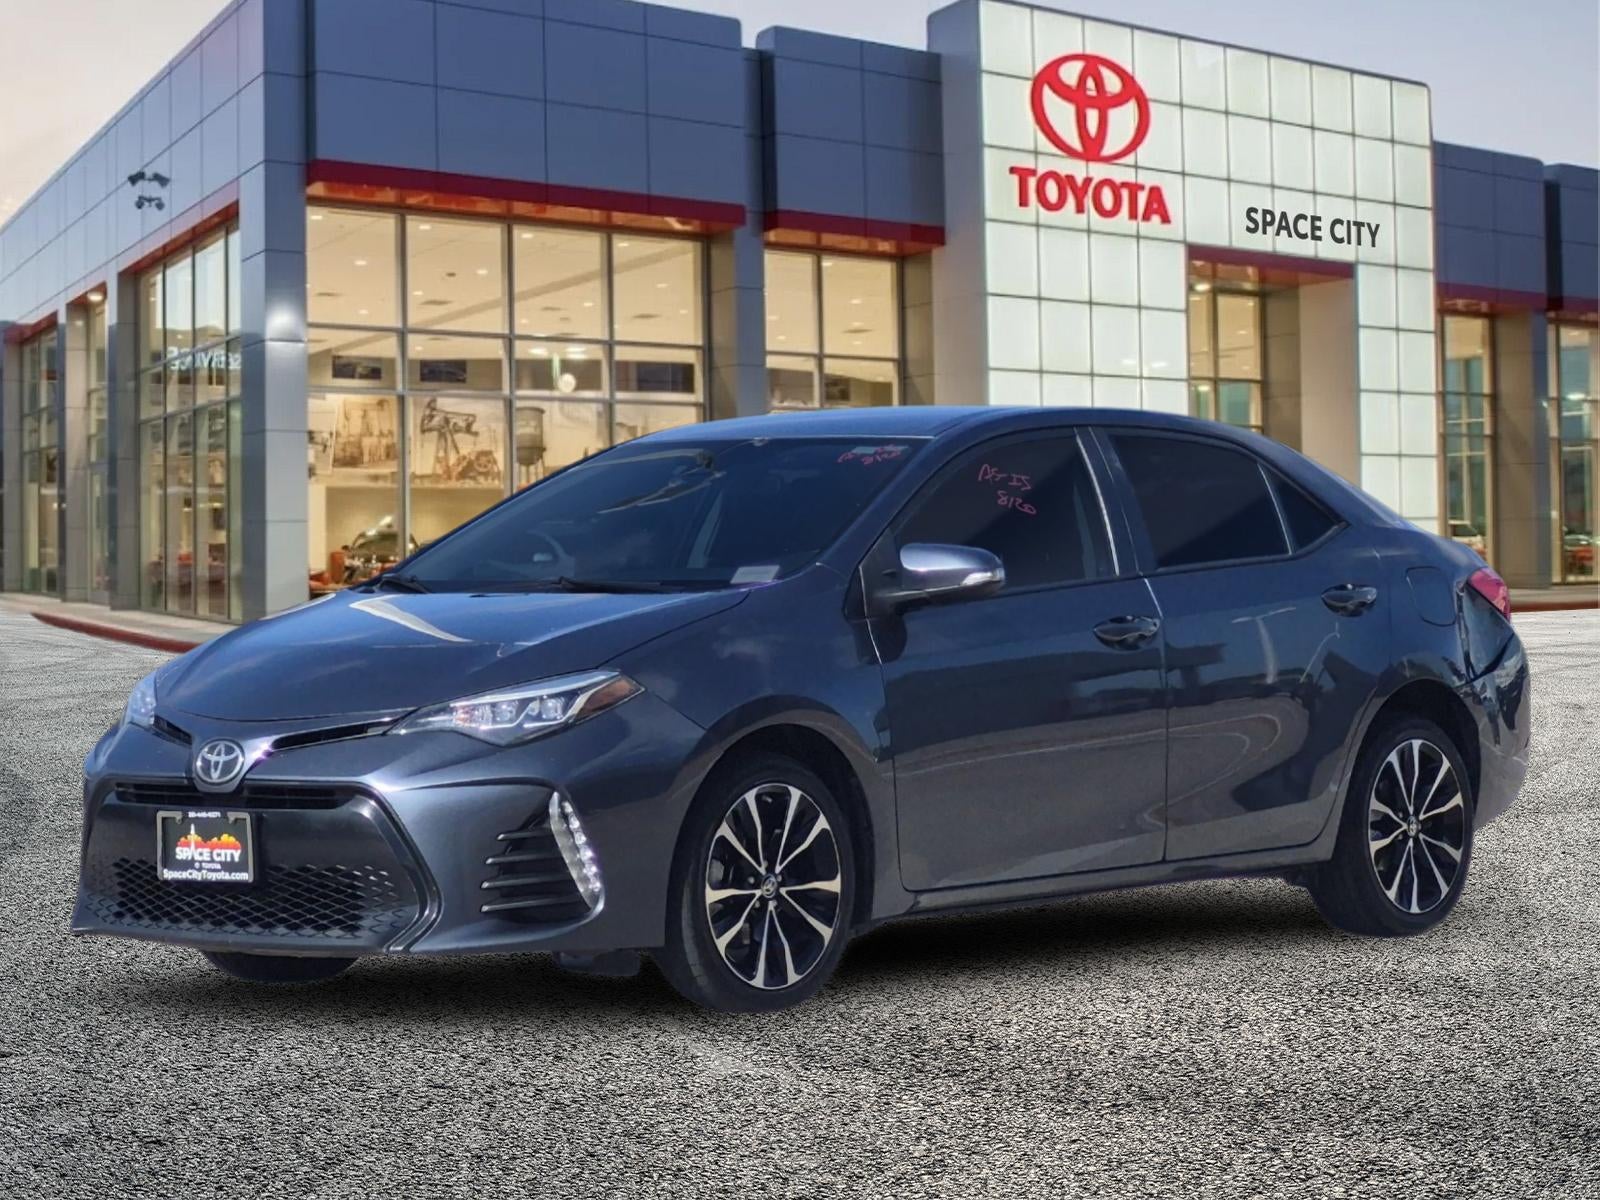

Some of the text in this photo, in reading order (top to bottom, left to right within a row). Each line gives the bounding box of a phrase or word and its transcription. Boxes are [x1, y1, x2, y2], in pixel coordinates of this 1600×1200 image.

[1009, 166, 1171, 225] TOYOTA
[1245, 206, 1381, 248] SPACE CITY
[175, 846, 242, 863] SPACE CITY
[163, 868, 249, 881] SpaceCityToyota.com
